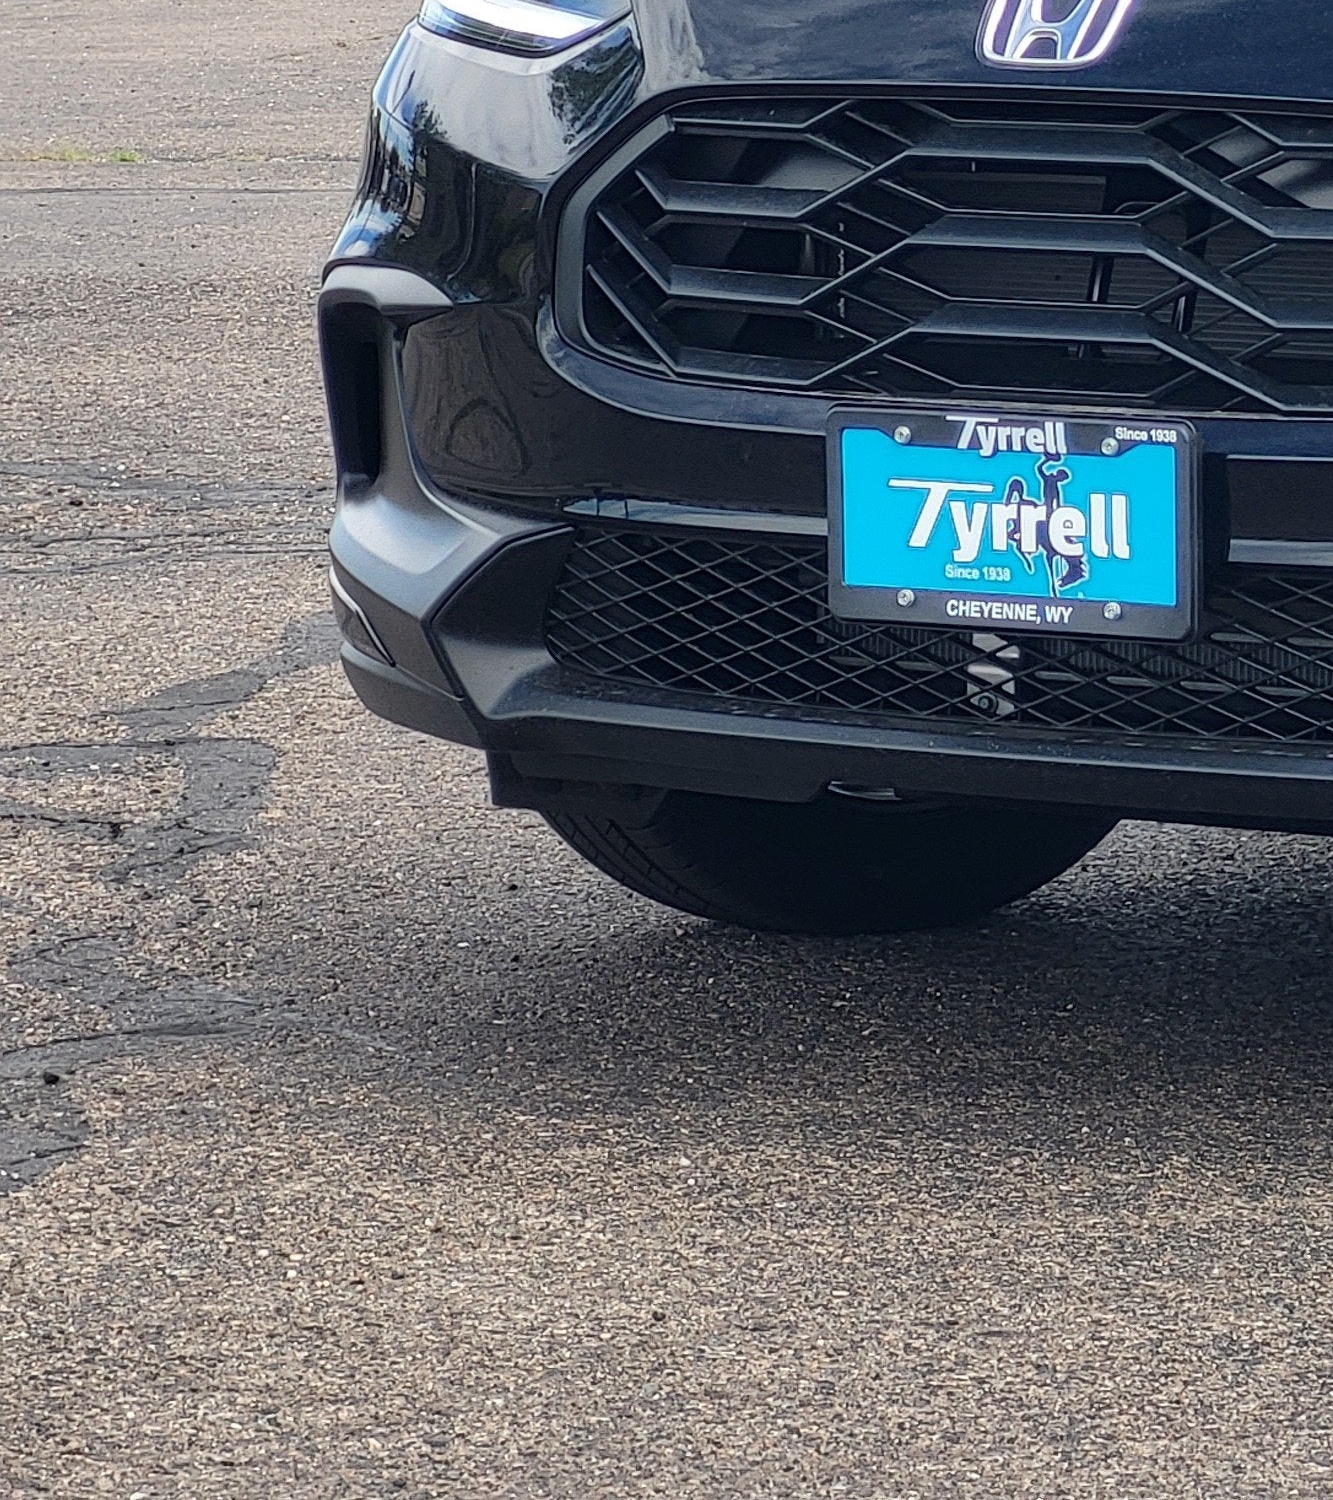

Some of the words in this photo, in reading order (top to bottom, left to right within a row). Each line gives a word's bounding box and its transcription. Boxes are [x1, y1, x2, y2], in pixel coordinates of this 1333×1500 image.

[945, 414, 1068, 458] Tyrrell
[1114, 426, 1148, 442] Since
[1149, 428, 1177, 443] 1938
[888, 477, 1130, 563] Tyrrell
[944, 563, 980, 581] Since
[981, 564, 1011, 582] 1938
[945, 599, 1041, 624] CHEYENNE,
[1045, 603, 1074, 624] WY
